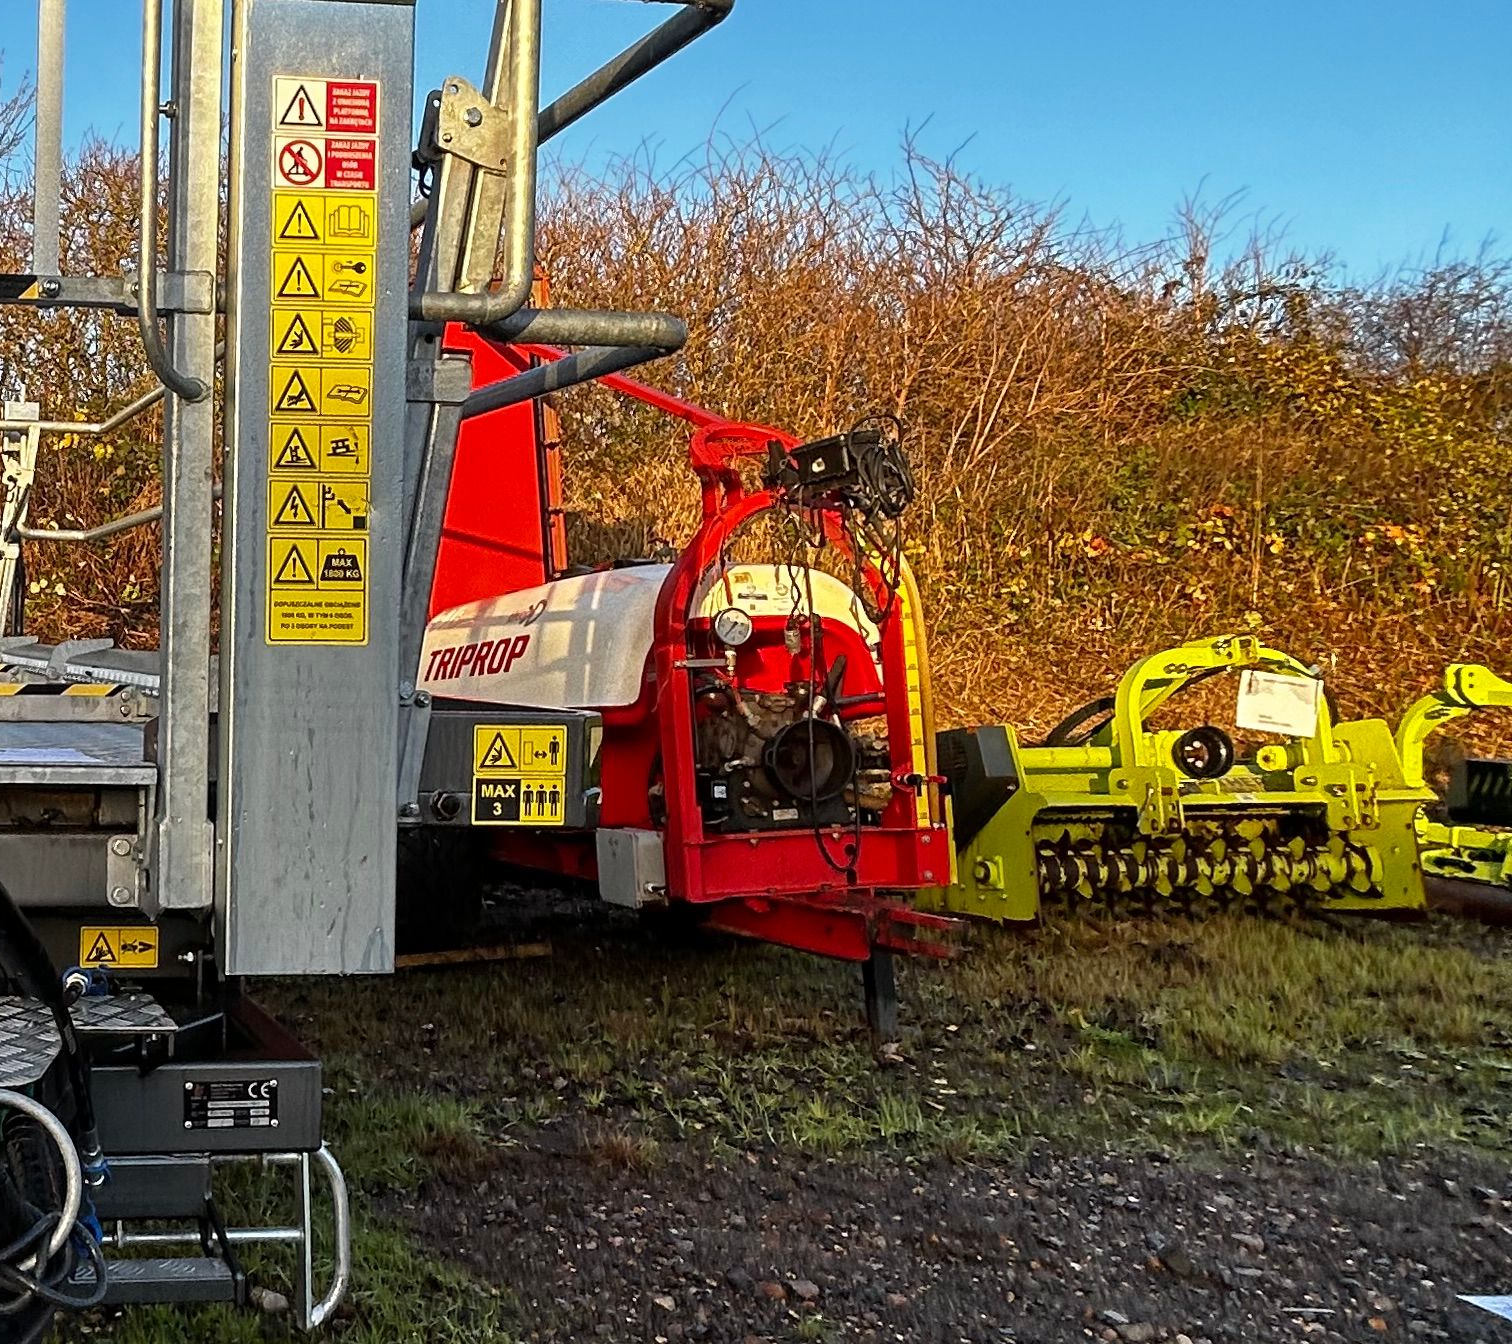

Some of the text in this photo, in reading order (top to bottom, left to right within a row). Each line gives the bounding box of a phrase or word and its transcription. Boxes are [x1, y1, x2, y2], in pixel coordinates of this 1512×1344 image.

[331, 558, 353, 567] MAX
[345, 569, 360, 578] KG
[424, 634, 531, 683] TRIPROP
[481, 783, 516, 799] MAX
[492, 801, 502, 816] 3
[248, 1081, 271, 1099] CE
